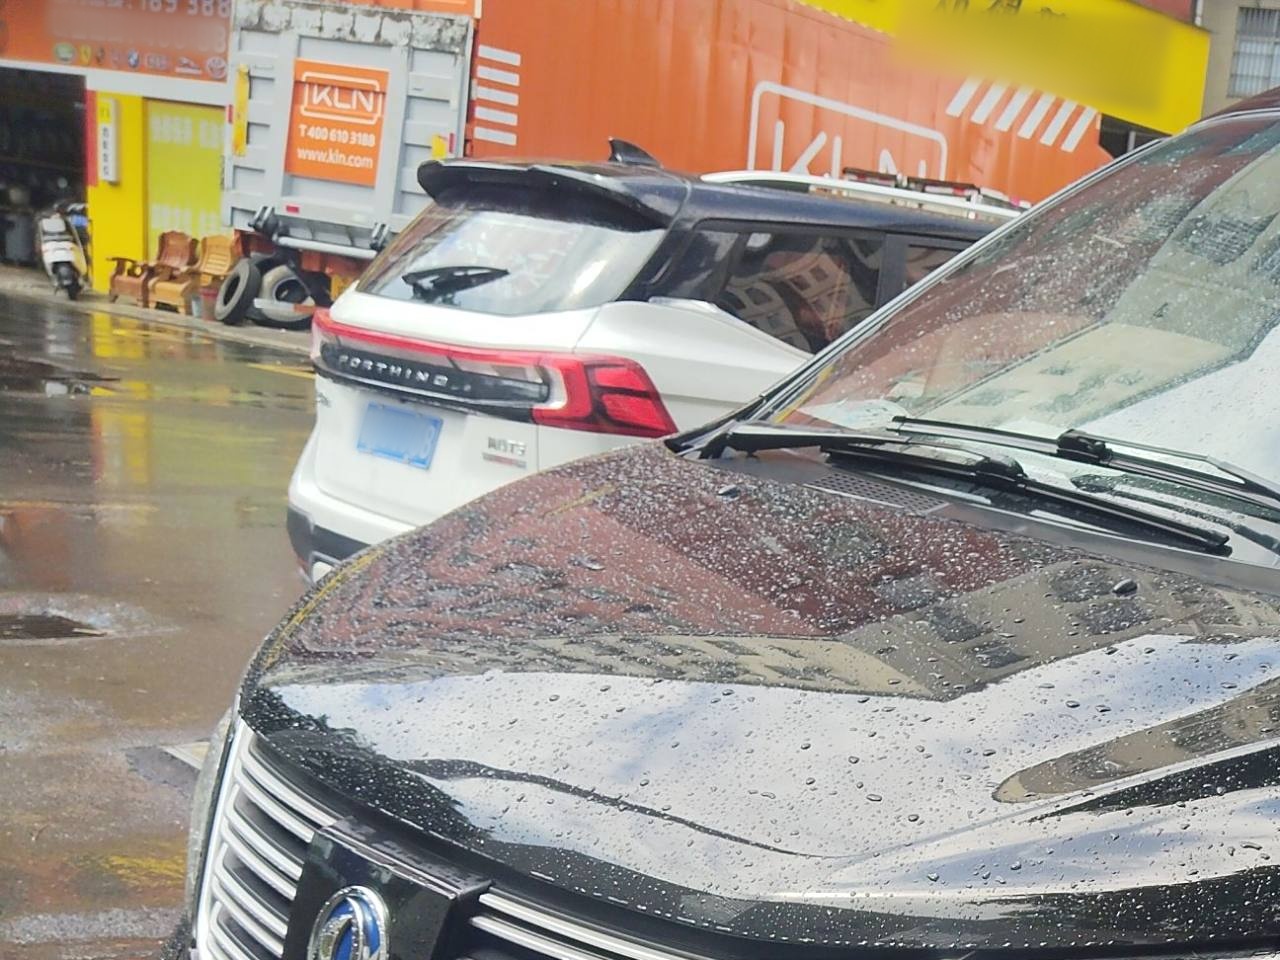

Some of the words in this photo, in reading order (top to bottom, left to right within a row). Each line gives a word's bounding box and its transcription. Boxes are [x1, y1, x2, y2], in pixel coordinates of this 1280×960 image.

[312, 84, 374, 112] KLN
[299, 124, 307, 137] T
[307, 126, 329, 141] 400
[297, 147, 374, 169] www.kln.com
